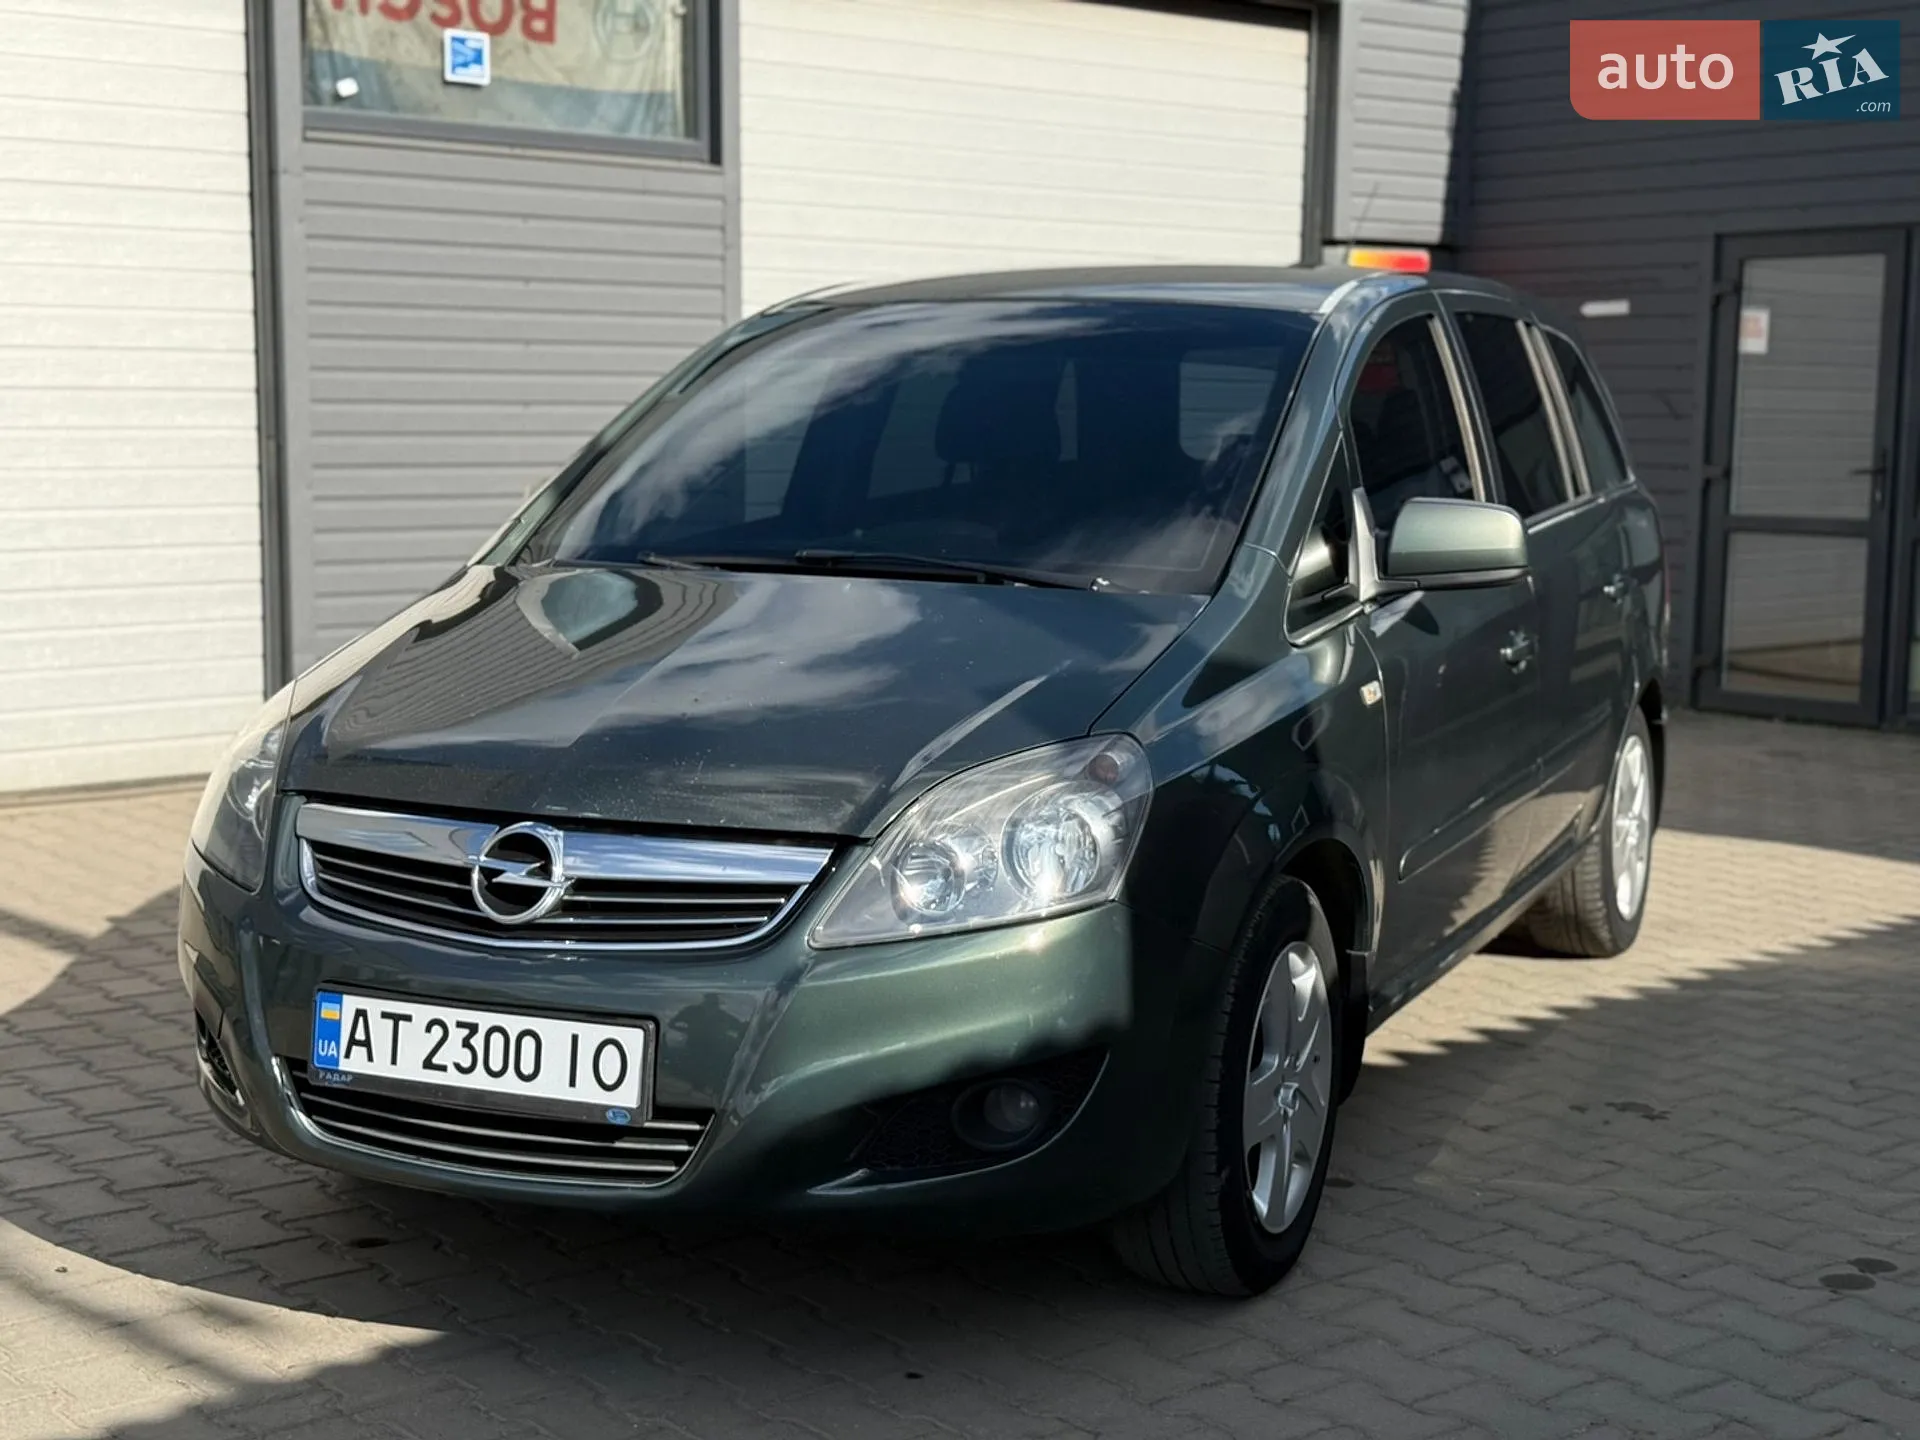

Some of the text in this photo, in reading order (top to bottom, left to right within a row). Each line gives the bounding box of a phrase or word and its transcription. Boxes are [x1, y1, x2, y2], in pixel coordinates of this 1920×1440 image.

[331, 0, 558, 45] BOS
[318, 1039, 338, 1057] UA
[344, 1008, 628, 1093] AT 2300 IO
